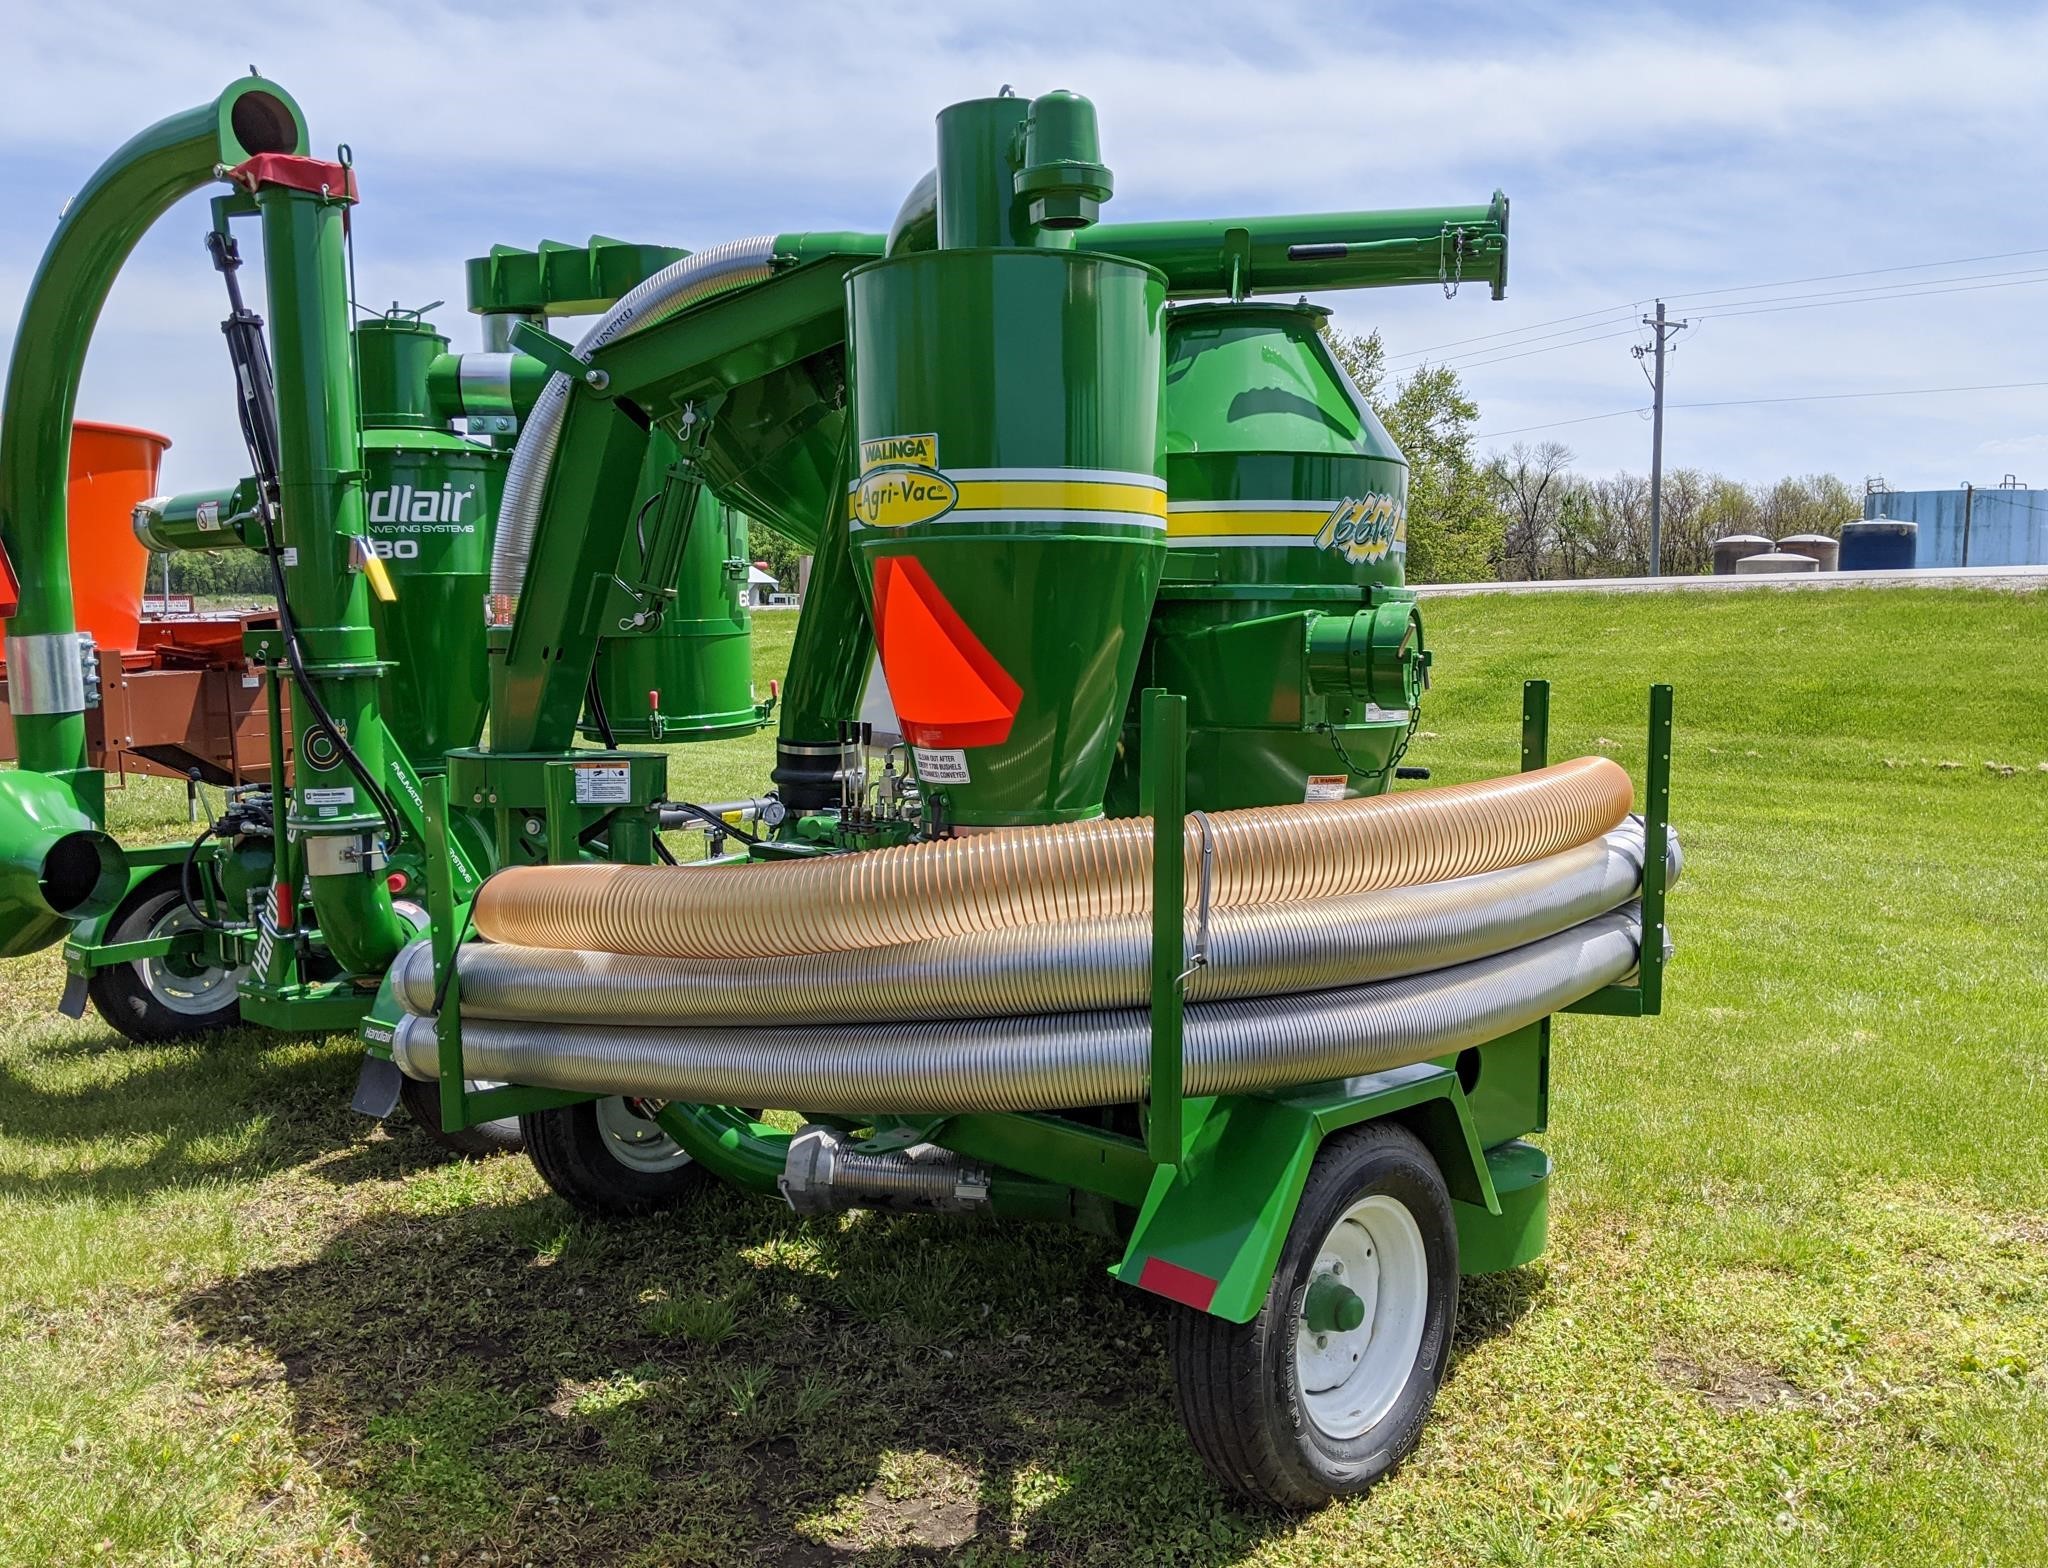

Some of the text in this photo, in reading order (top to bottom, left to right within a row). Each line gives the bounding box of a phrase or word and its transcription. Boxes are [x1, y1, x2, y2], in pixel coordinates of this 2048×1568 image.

[865, 439, 927, 463] WALINGA
[365, 482, 474, 522] dlair
[857, 480, 948, 520] Agri-Vac
[422, 524, 475, 533] SYSTEMS
[939, 755, 955, 763] AFTER
[939, 763, 962, 771] BUSHELS
[390, 761, 423, 807] PNEUMATIC
[940, 771, 967, 779] CONVEYED
[364, 1026, 393, 1044] Handlair
